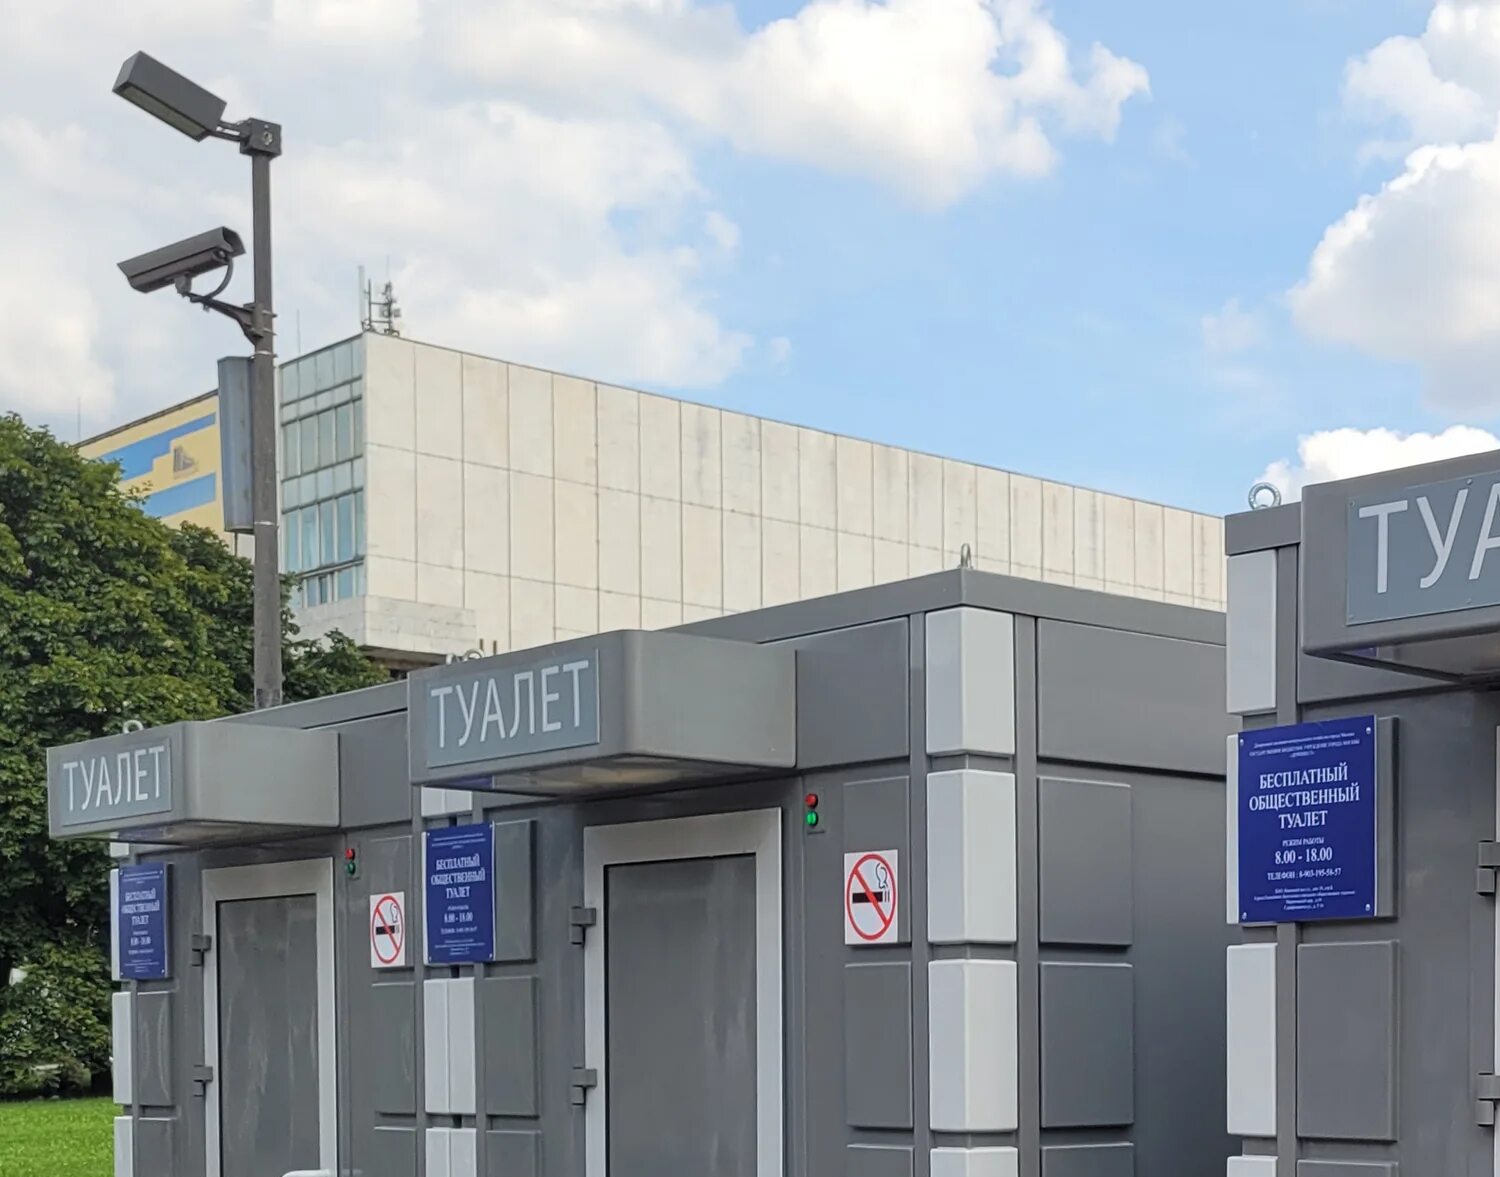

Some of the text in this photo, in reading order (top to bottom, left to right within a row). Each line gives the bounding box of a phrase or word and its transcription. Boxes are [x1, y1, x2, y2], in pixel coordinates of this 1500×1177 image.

[430, 659, 590, 748] ТУАЛЕТ
[62, 745, 166, 812] ТУАЛЕТ
[1259, 762, 1348, 789] БЕСПЛАТНЫЙ
[1248, 782, 1360, 811] ОБЩЕСТВЕННЫЙ
[1278, 810, 1328, 829] ТУАЛЕТ
[436, 853, 480, 871] БЕСПЛАТНЫЙ
[1275, 850, 1296, 865] 8.00
[1305, 846, 1333, 863] 18.00
[430, 867, 486, 886] ОБЩЕСТВЕННЫЙ
[445, 886, 471, 899] ТУАЛЕТ
